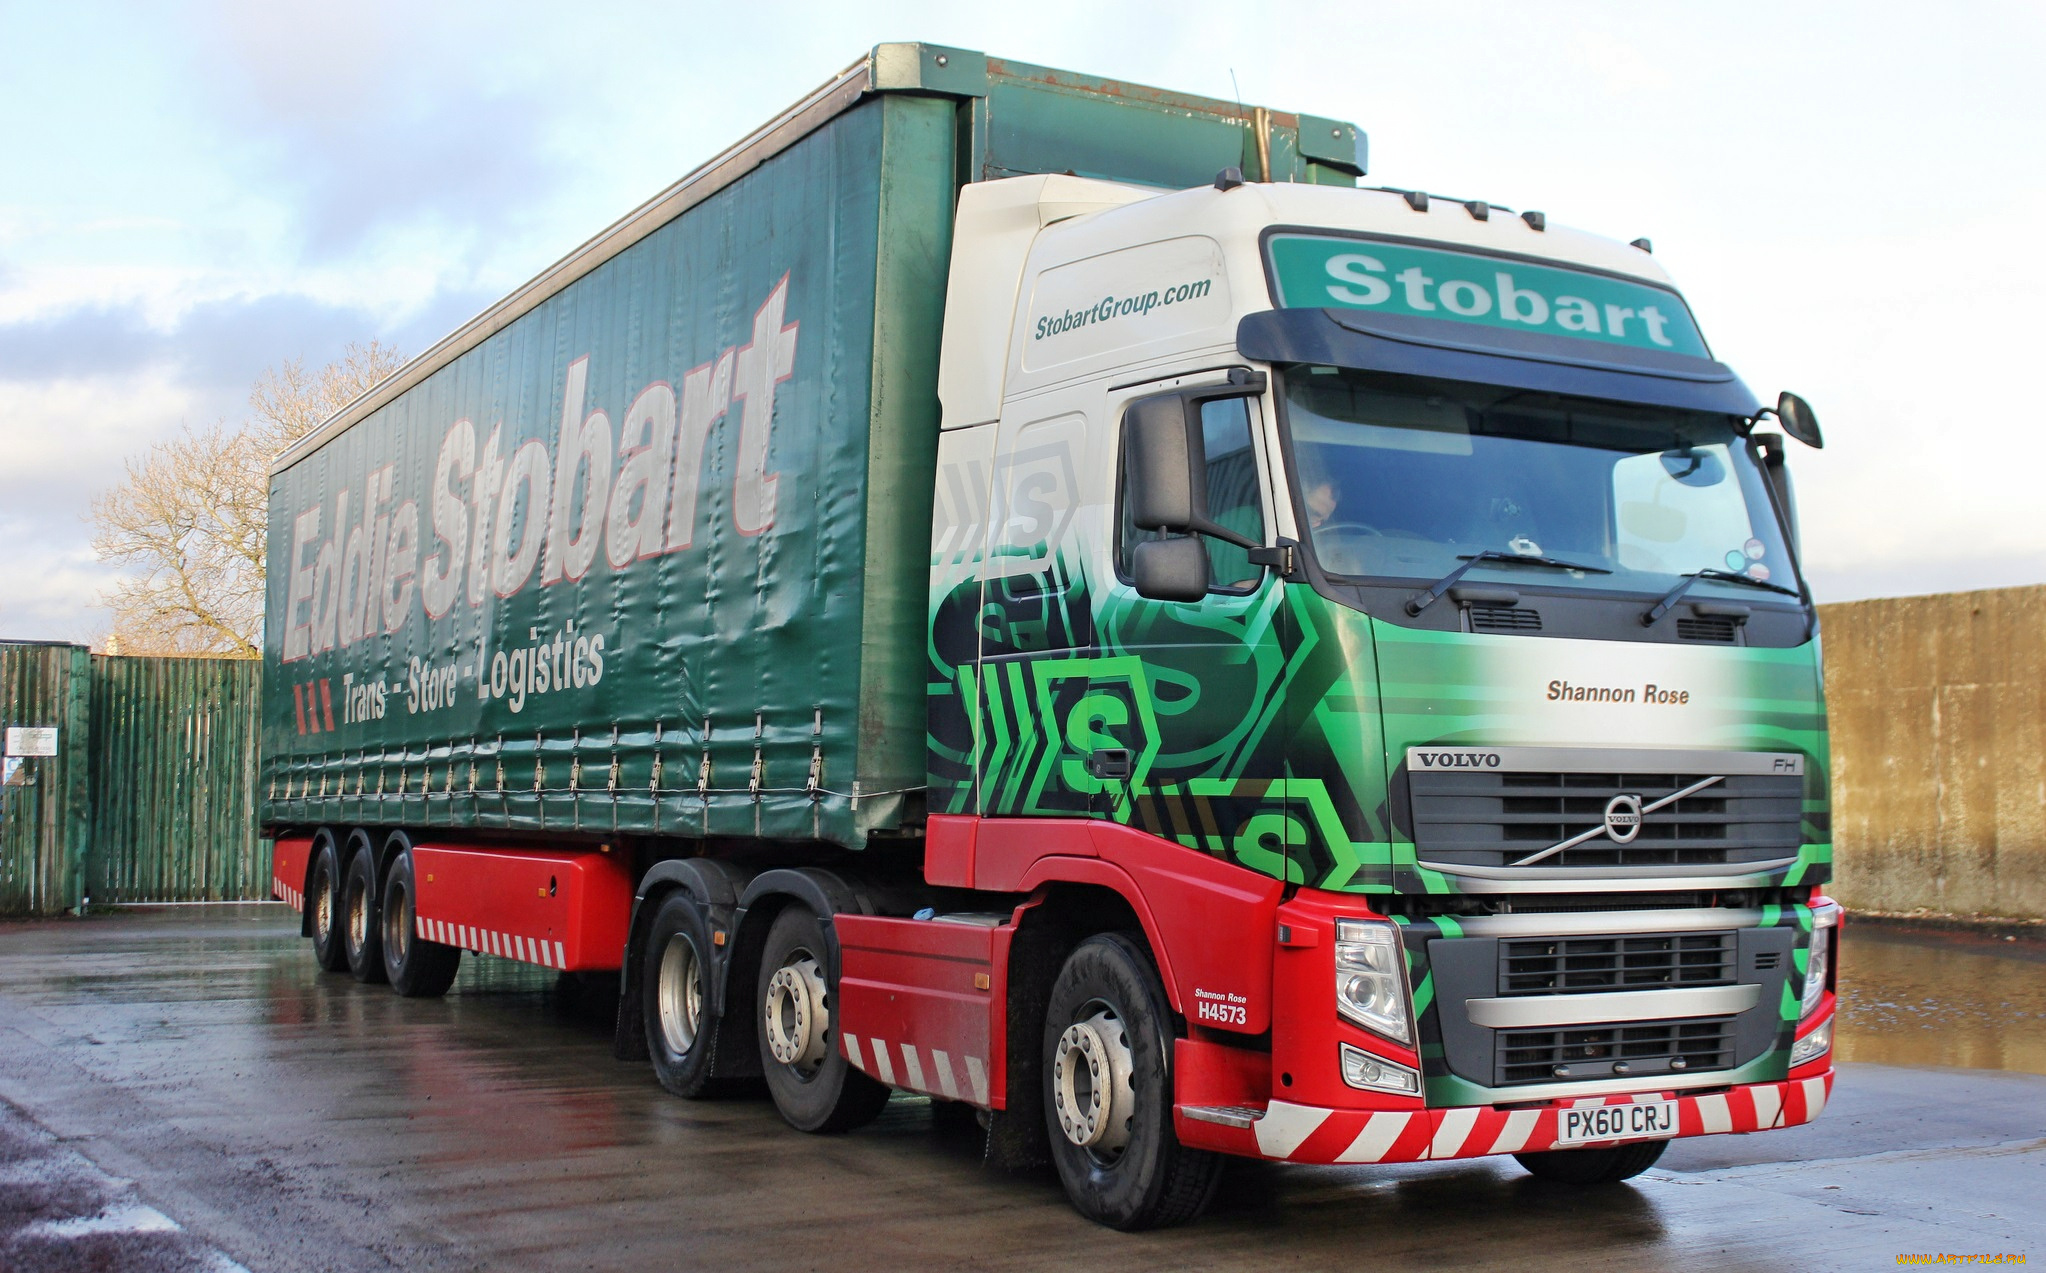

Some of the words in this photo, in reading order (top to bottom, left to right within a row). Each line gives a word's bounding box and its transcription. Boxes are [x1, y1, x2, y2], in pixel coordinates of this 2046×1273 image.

[1035, 276, 1211, 340] StobartGroup.com
[1325, 253, 1673, 347] Stobart
[283, 465, 419, 663] Eddie
[422, 269, 799, 619] Stobart
[343, 673, 387, 724] Trans
[408, 656, 457, 715] Store
[478, 619, 605, 713] Logistics
[1547, 680, 1635, 704] Shannon
[1643, 684, 1690, 706] Rose
[1418, 753, 1501, 768] VOLVO
[1773, 758, 1796, 773] FH
[1608, 815, 1640, 823] VOLVO
[1195, 988, 1225, 1001] Shannon
[1228, 993, 1247, 1004] Rose
[1199, 1001, 1247, 1025] H4573
[1567, 1108, 1623, 1138] PX60
[1632, 1104, 1671, 1132] CRJ
